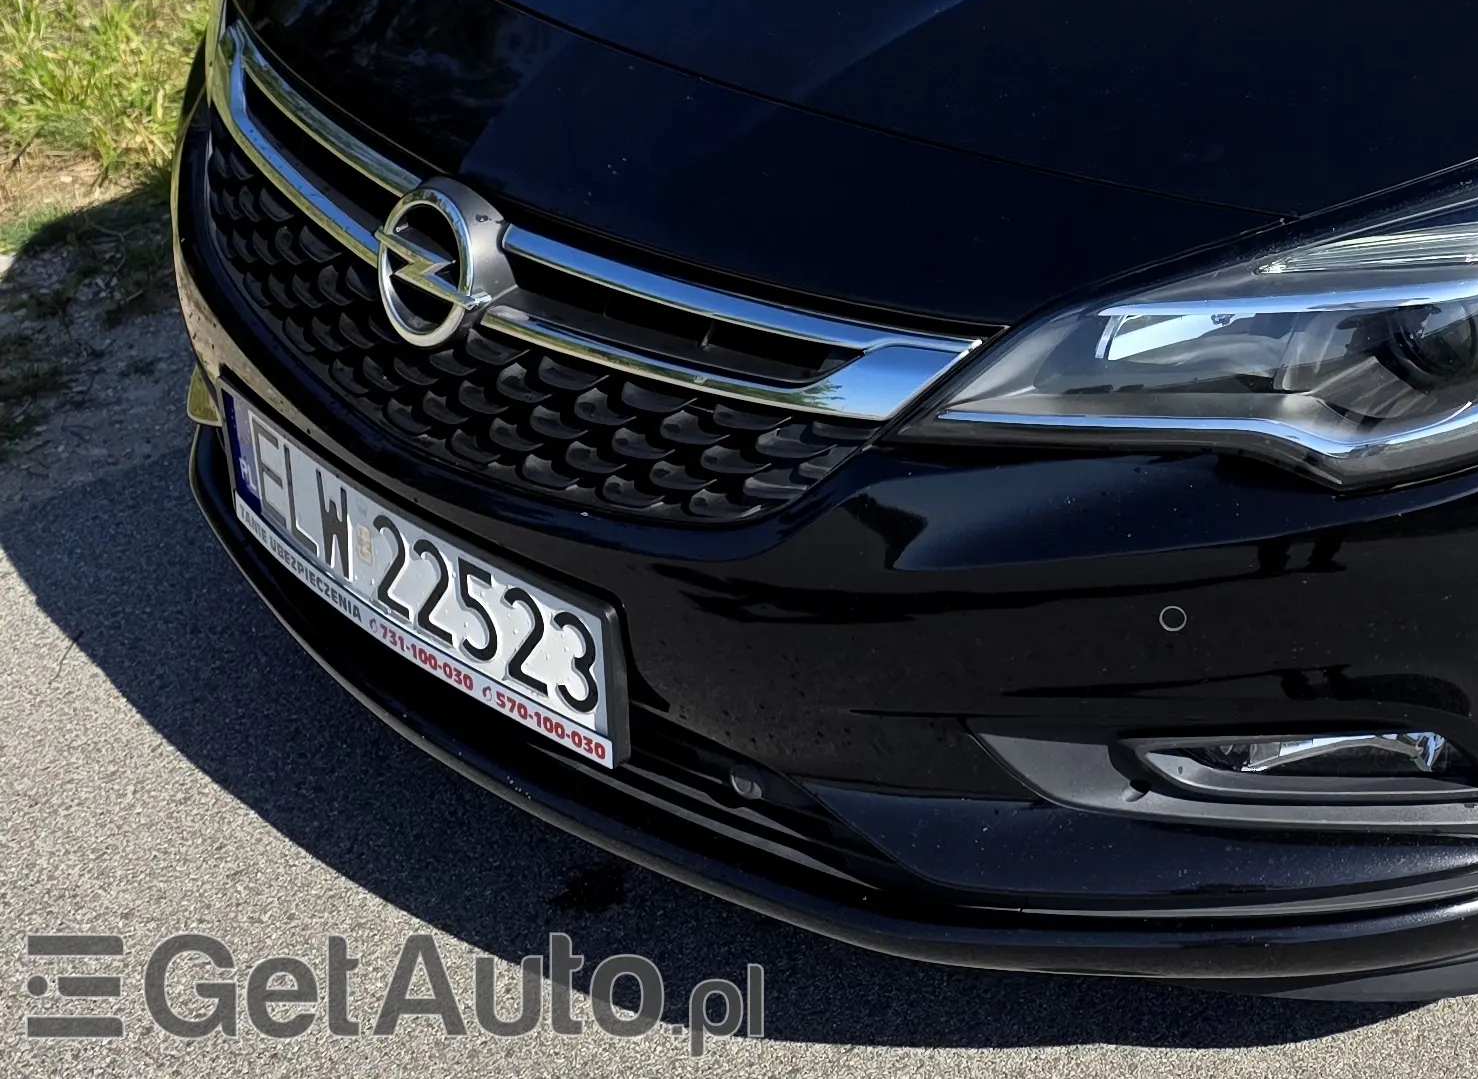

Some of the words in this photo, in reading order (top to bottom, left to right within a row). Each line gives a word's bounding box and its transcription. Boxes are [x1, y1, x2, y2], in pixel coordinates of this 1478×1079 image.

[239, 457, 258, 492] PL
[253, 422, 350, 581] ELW
[373, 514, 599, 714] 22523
[239, 502, 268, 543] TANIE
[270, 536, 363, 623] UBEZPIECZENIA
[379, 623, 474, 691] 731-100-030
[495, 690, 606, 760] 570-100-030
